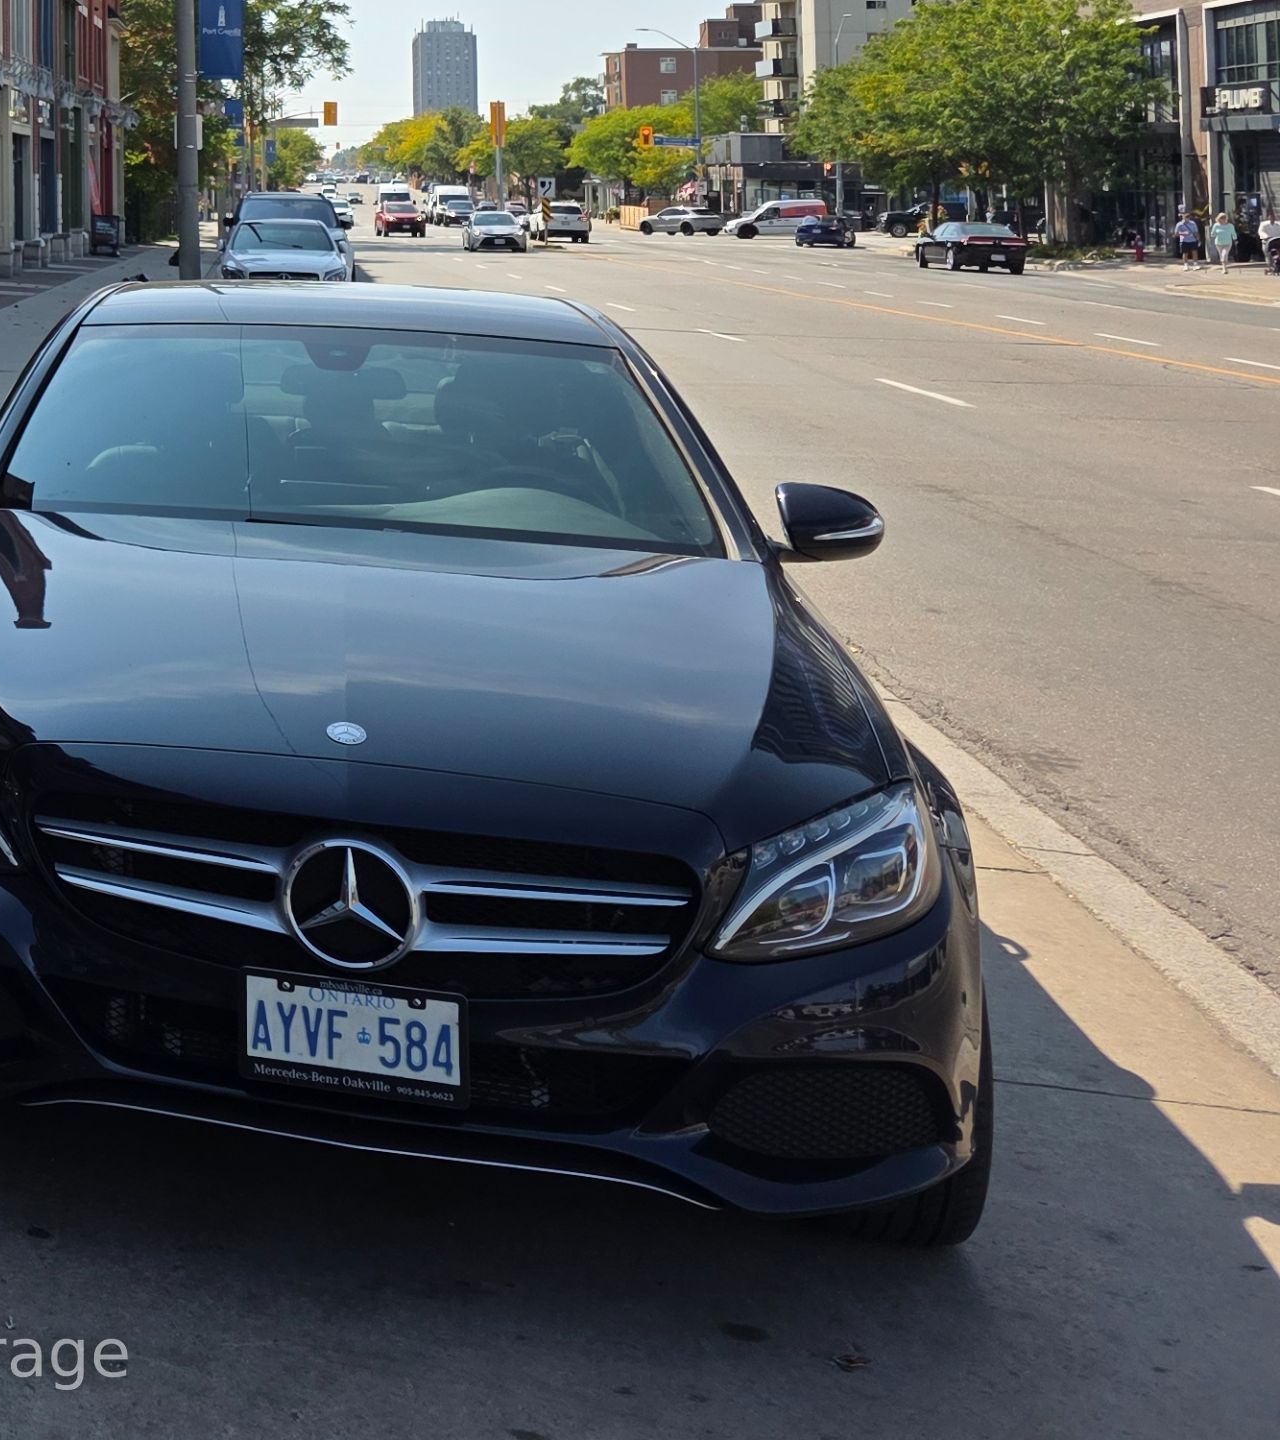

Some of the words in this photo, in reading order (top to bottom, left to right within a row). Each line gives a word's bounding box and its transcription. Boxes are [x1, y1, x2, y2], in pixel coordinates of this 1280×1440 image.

[1220, 88, 1263, 110] PLUMB
[308, 987, 396, 1011] ONTARIO
[251, 999, 349, 1060] AYVF
[378, 1016, 454, 1078] 584
[253, 1063, 340, 1086] Mercedes-Benz
[342, 1075, 391, 1093] Oakville
